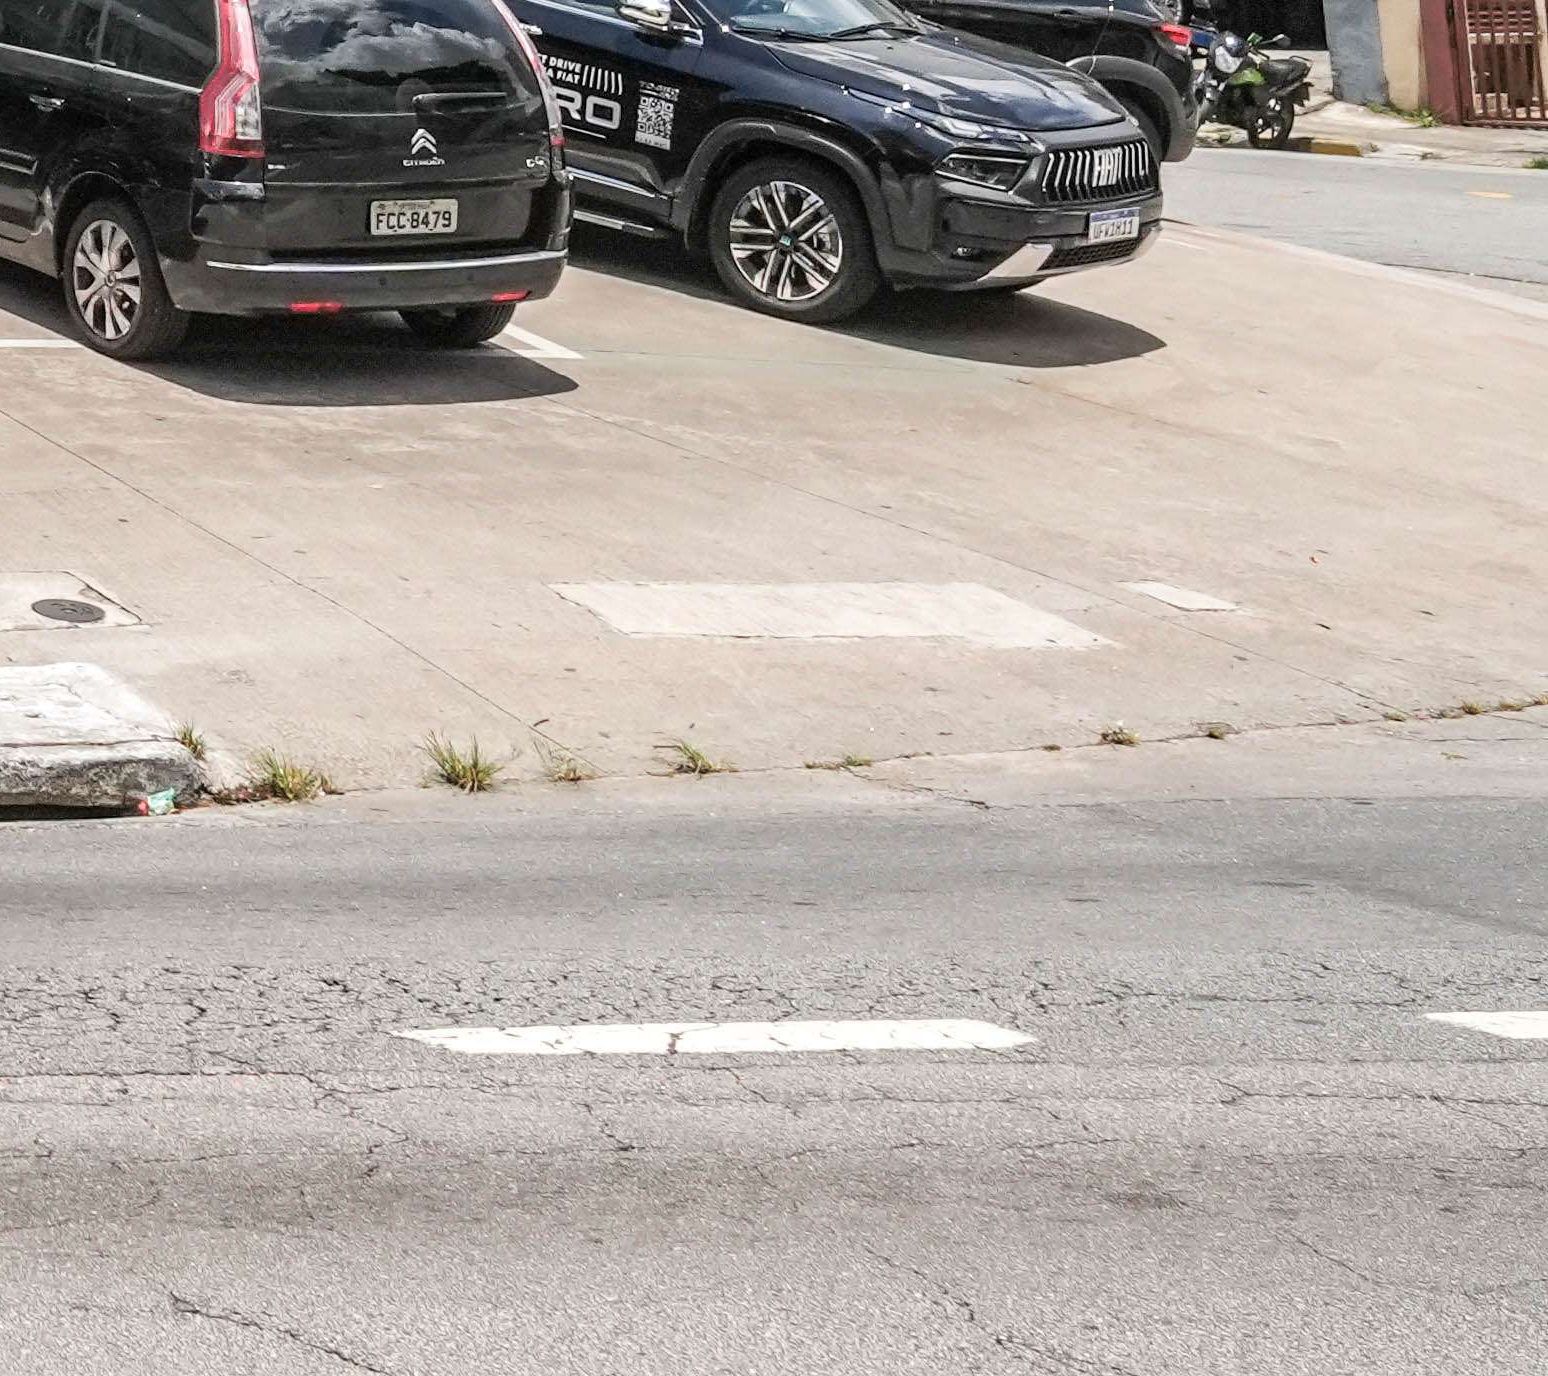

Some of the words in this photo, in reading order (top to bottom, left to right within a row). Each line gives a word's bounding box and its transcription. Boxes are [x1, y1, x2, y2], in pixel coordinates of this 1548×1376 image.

[549, 57, 582, 72] DRIVE
[556, 70, 581, 84] FIAT
[553, 85, 621, 130] RO
[1092, 147, 1122, 187] FIAT
